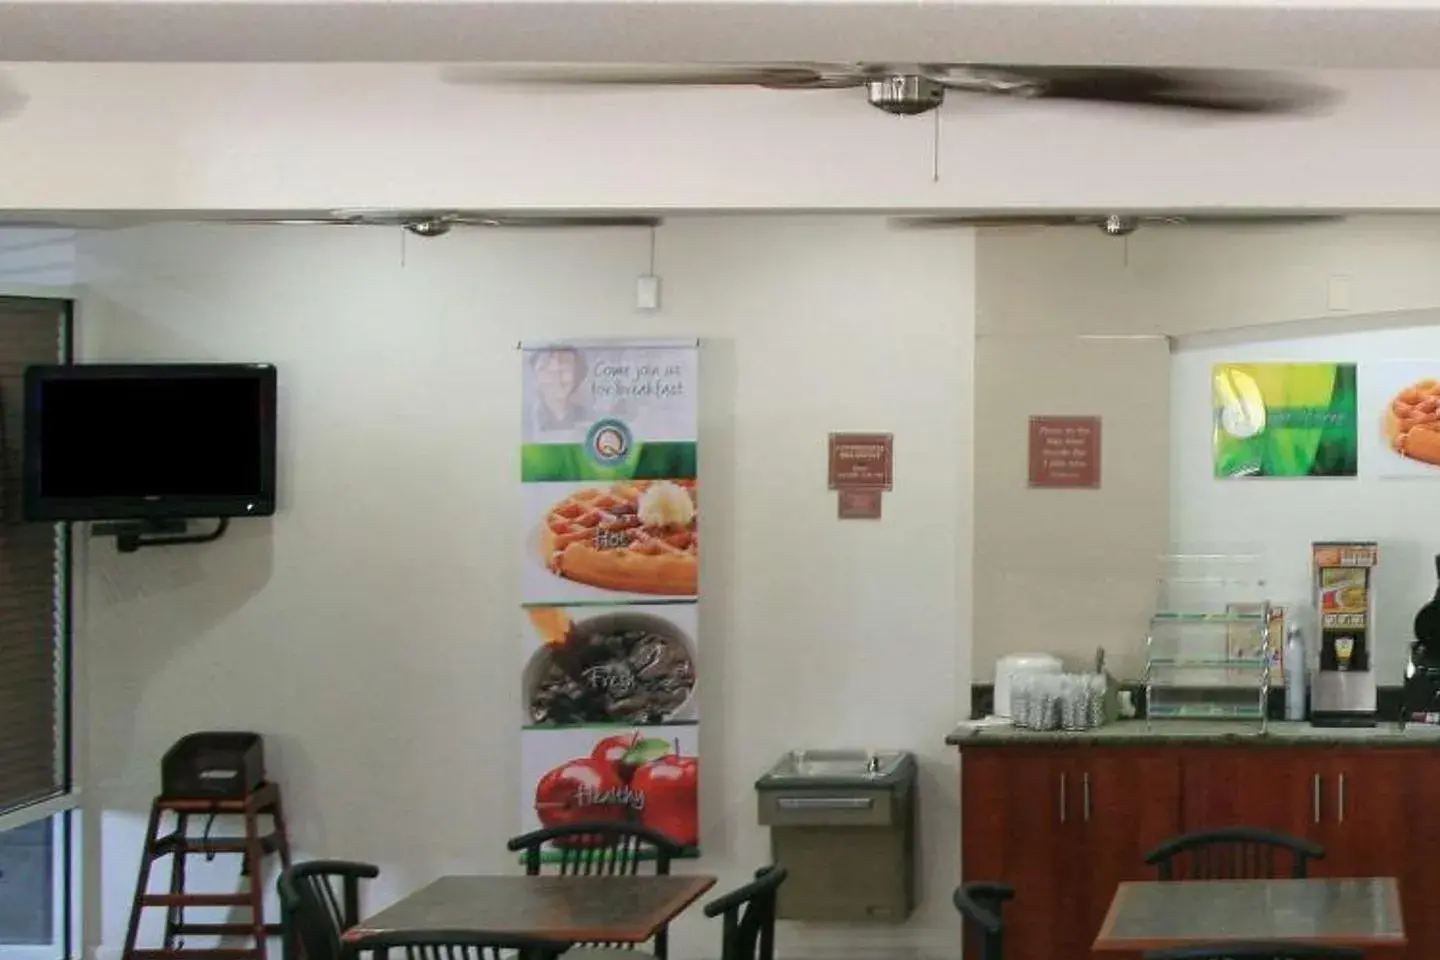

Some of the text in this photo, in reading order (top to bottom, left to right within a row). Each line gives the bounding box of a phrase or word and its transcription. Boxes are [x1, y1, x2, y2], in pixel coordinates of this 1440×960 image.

[595, 361, 682, 381] Come join us
[614, 379, 684, 399] breakfast
[593, 528, 629, 551] Hot
[588, 665, 636, 690] Fresh
[575, 784, 645, 810] Healthy
